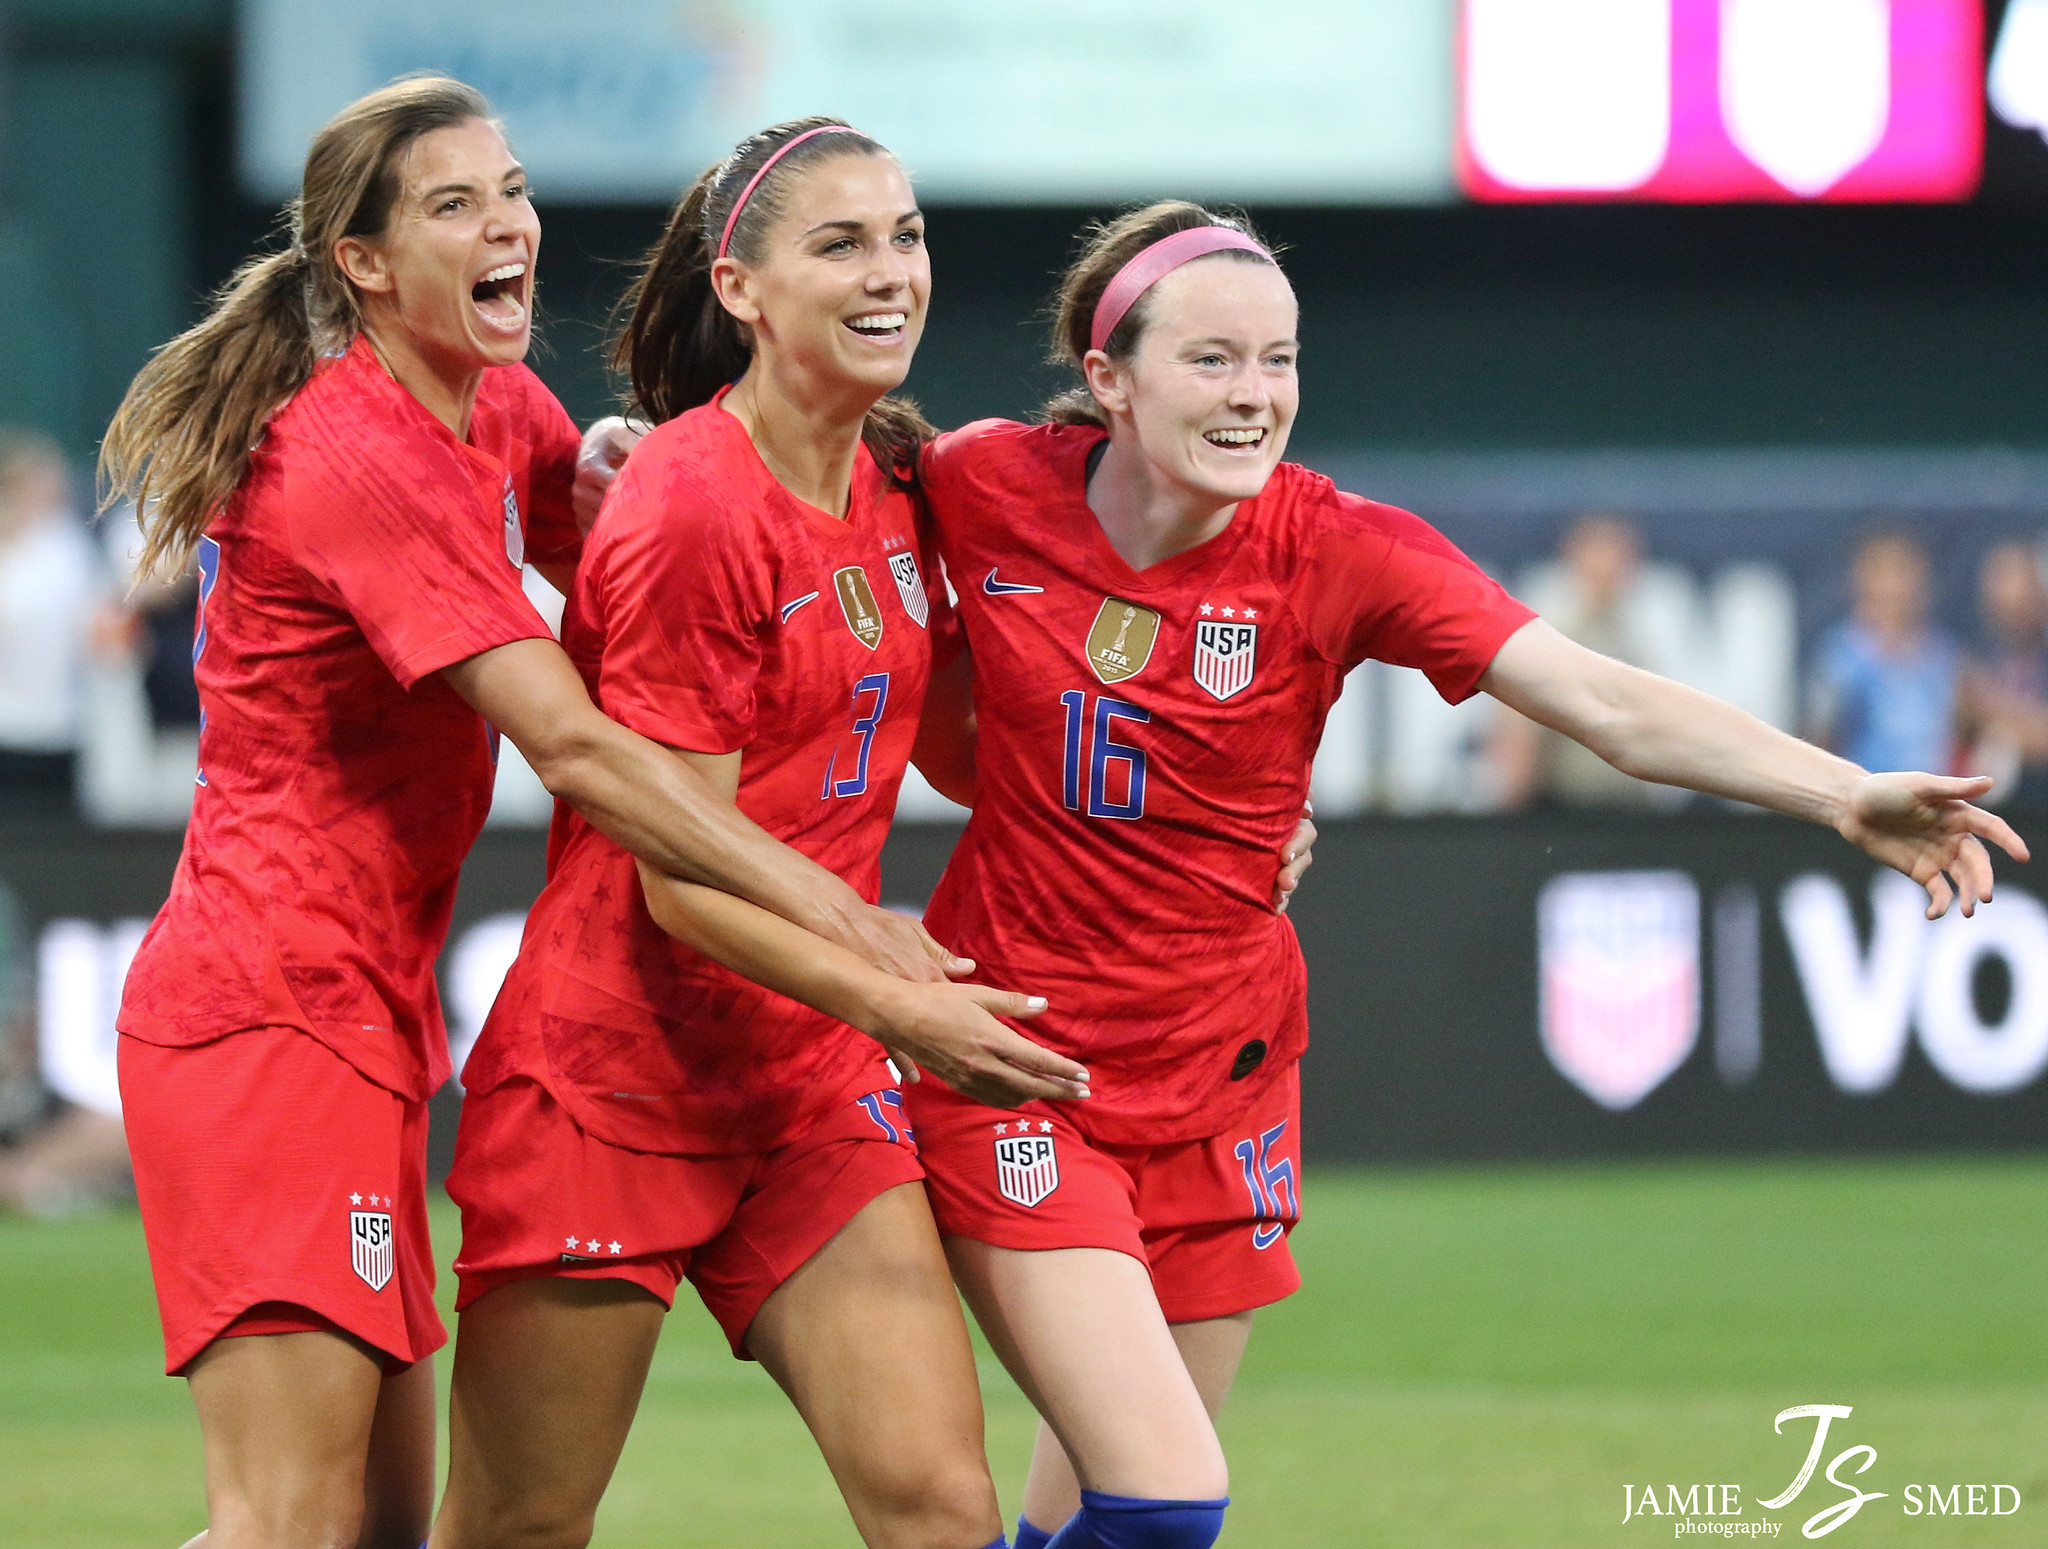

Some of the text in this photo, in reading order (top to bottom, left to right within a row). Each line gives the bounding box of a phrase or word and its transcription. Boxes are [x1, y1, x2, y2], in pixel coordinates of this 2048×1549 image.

[892, 551, 918, 587] USA
[857, 616, 875, 630] FIFA
[1200, 625, 1252, 656] USA
[1100, 648, 1127, 666] FIFA
[1102, 664, 1118, 673] 2015
[1060, 689, 1151, 820] 16
[1000, 1140, 1050, 1167] USA
[355, 1216, 390, 1247] USA
